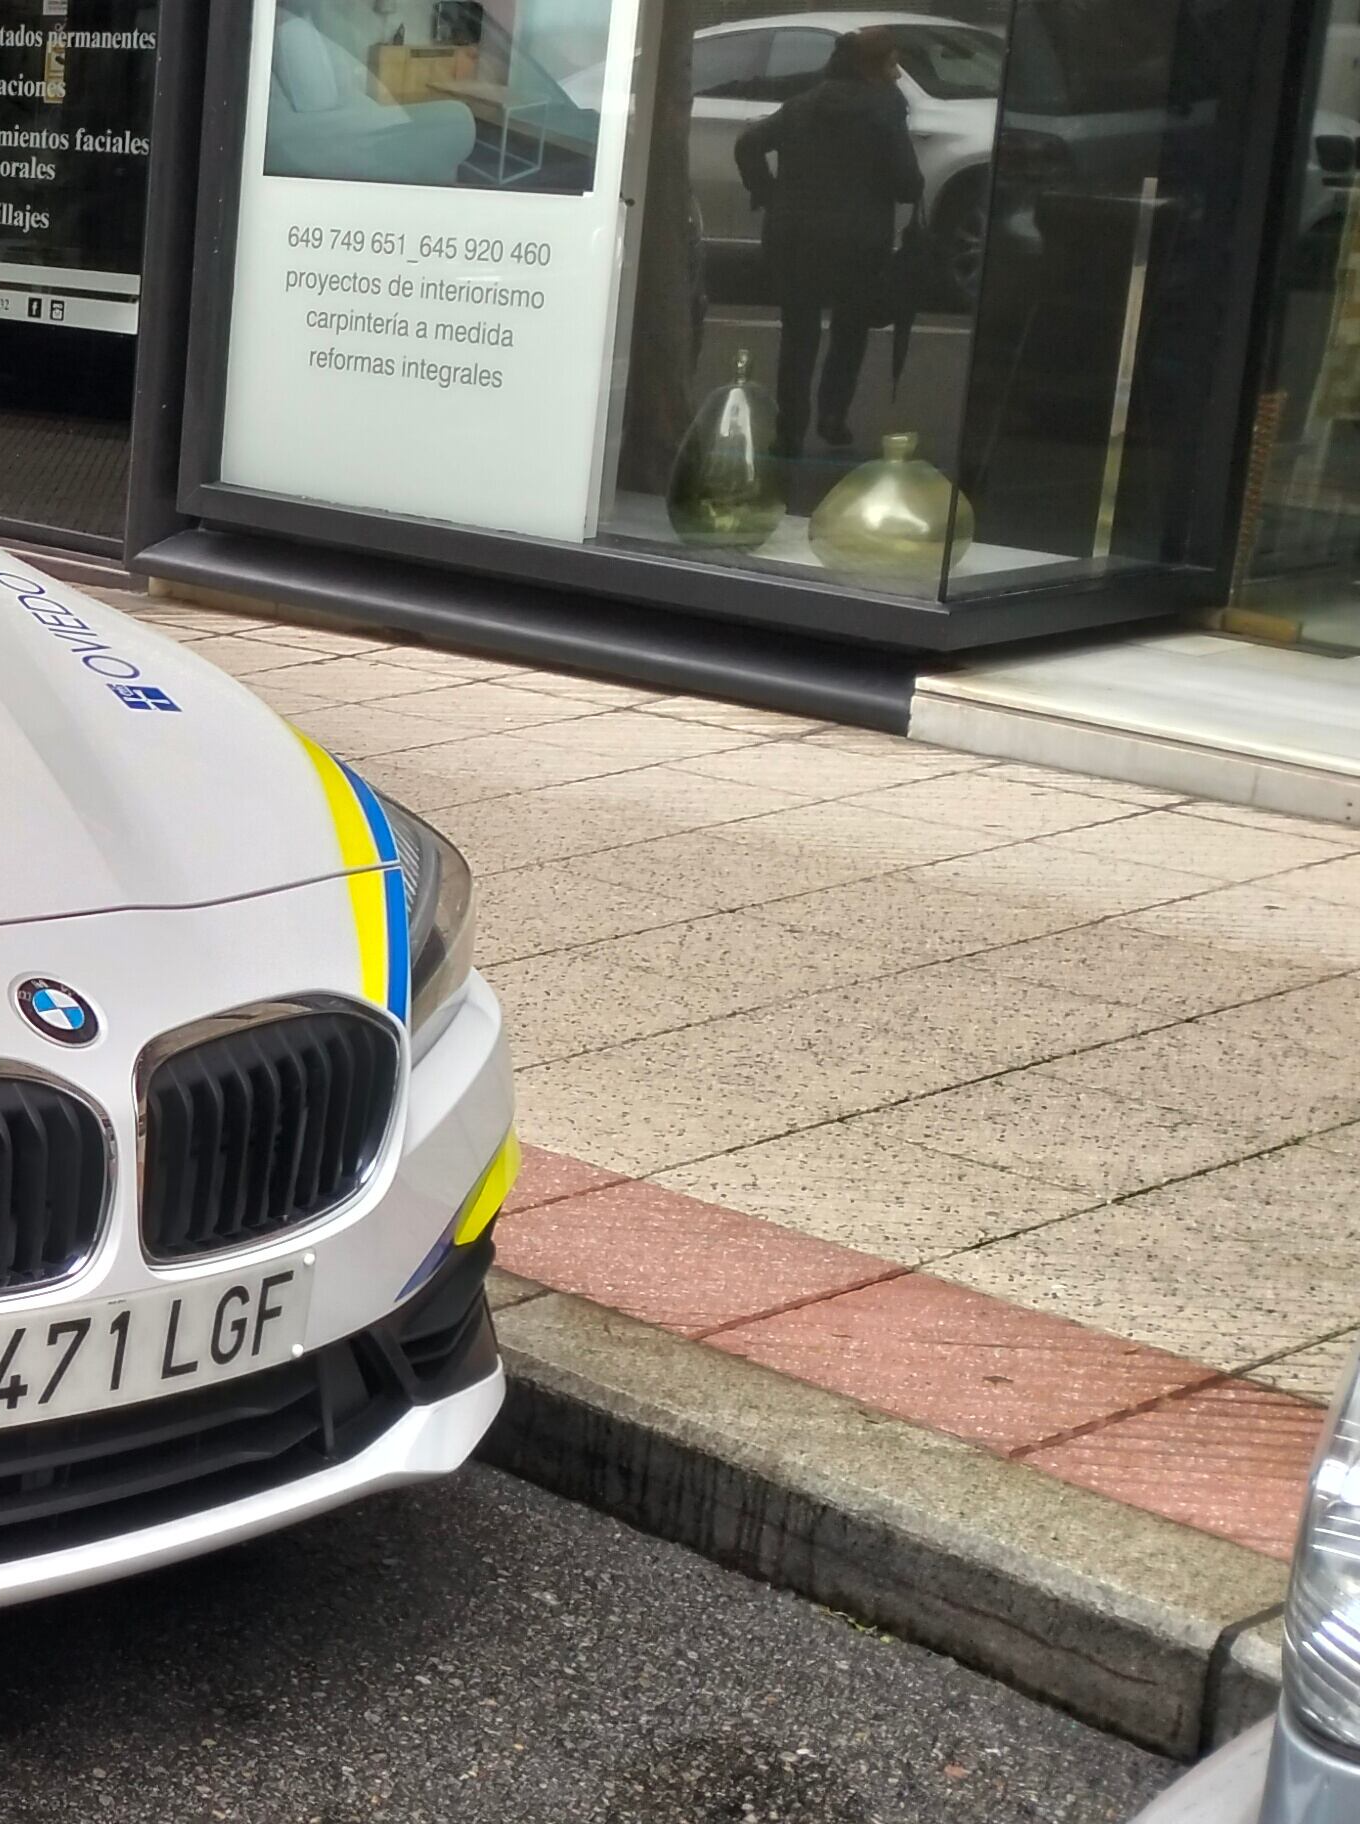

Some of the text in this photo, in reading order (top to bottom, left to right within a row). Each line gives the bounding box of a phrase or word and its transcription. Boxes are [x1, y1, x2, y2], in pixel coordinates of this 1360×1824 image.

[48, 27, 157, 53] permanentes
[75, 127, 150, 155] faciales
[288, 225, 323, 249] 649
[330, 228, 365, 252] 749
[464, 238, 503, 262] 920
[510, 242, 551, 266] 460
[285, 269, 545, 309] proyectos de interiorismo
[306, 308, 514, 348] carpintería a medida
[309, 347, 503, 389] reformas integrales
[160, 1269, 295, 1381] LGF
